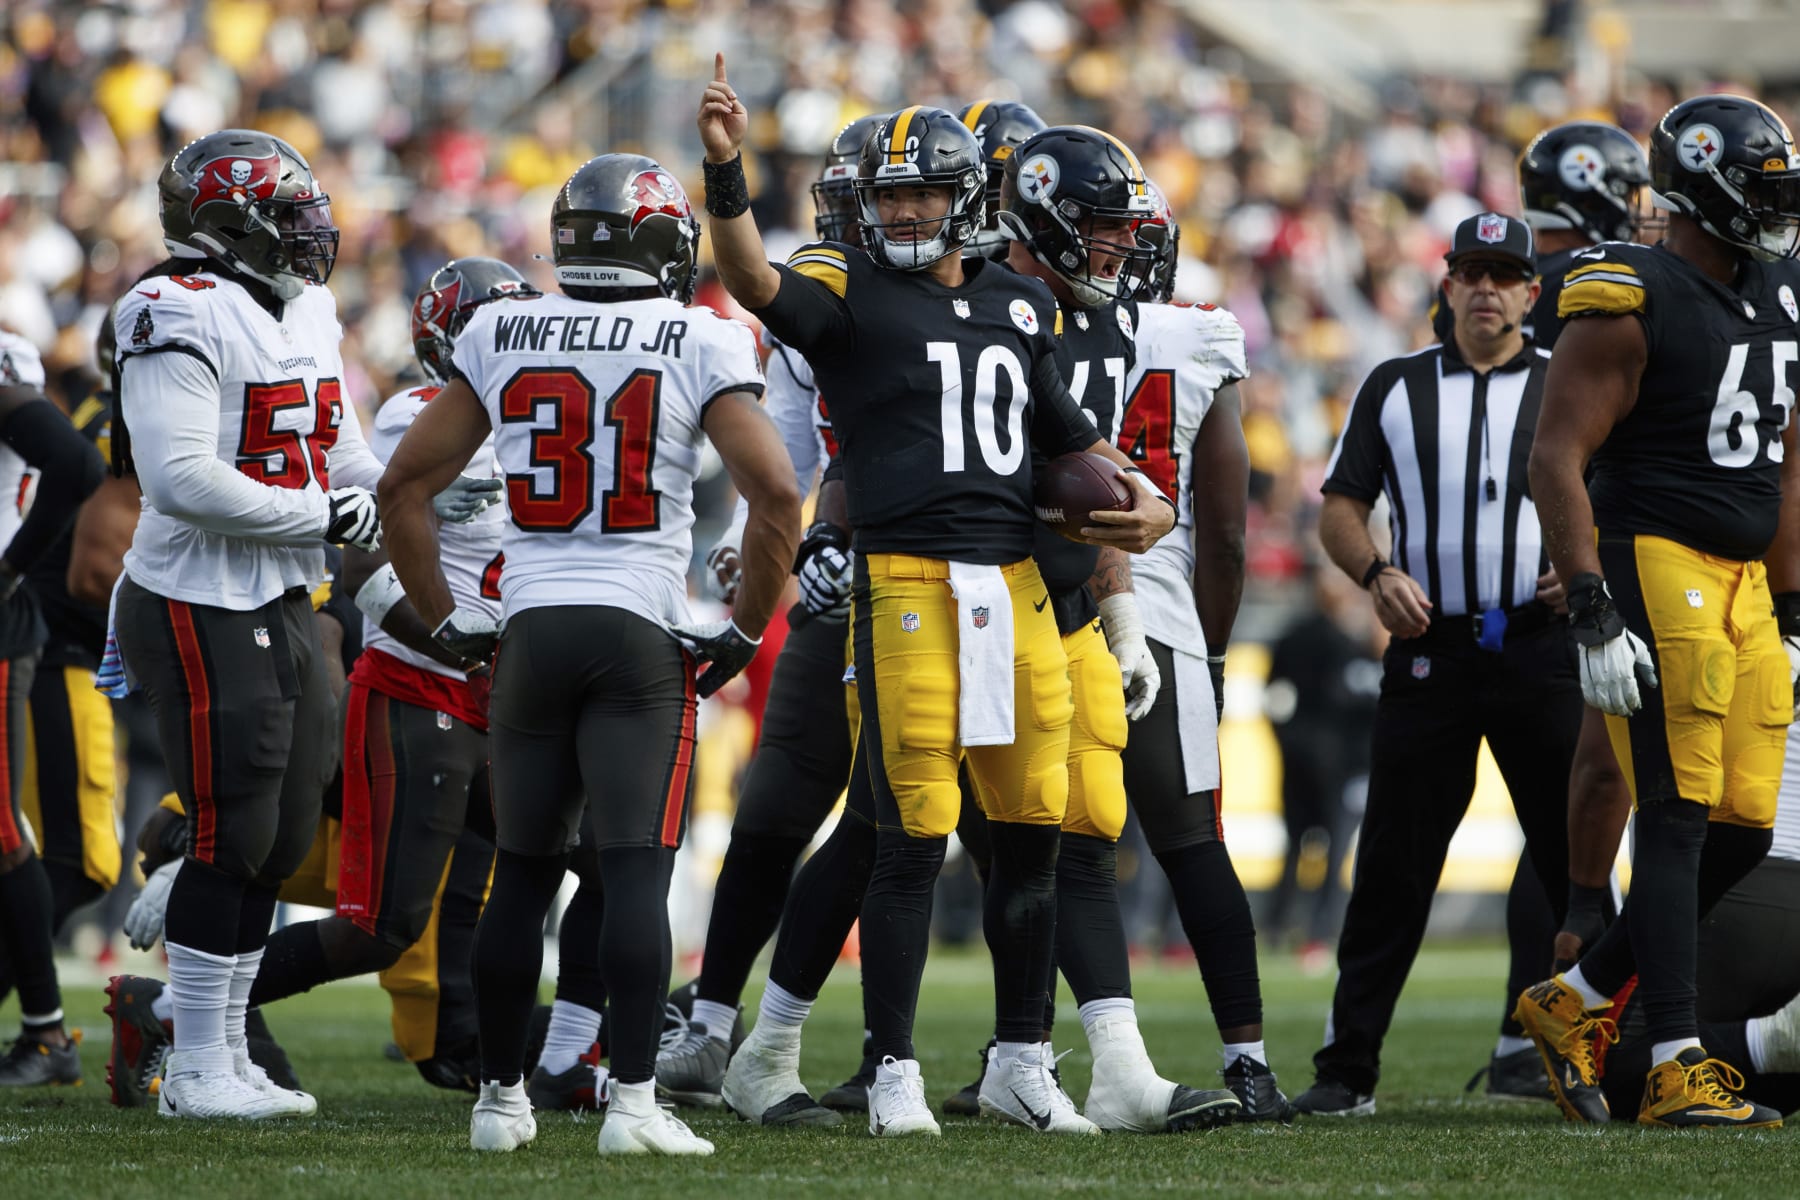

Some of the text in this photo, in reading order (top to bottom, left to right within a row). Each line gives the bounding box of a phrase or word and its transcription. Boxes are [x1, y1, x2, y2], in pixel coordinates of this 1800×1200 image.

[495, 315, 688, 359] WINFIELD JR
[561, 271, 620, 281] CHOOSE LOVE
[500, 366, 663, 534] 31
[926, 341, 1029, 476] 10
[1707, 341, 1799, 468] 65
